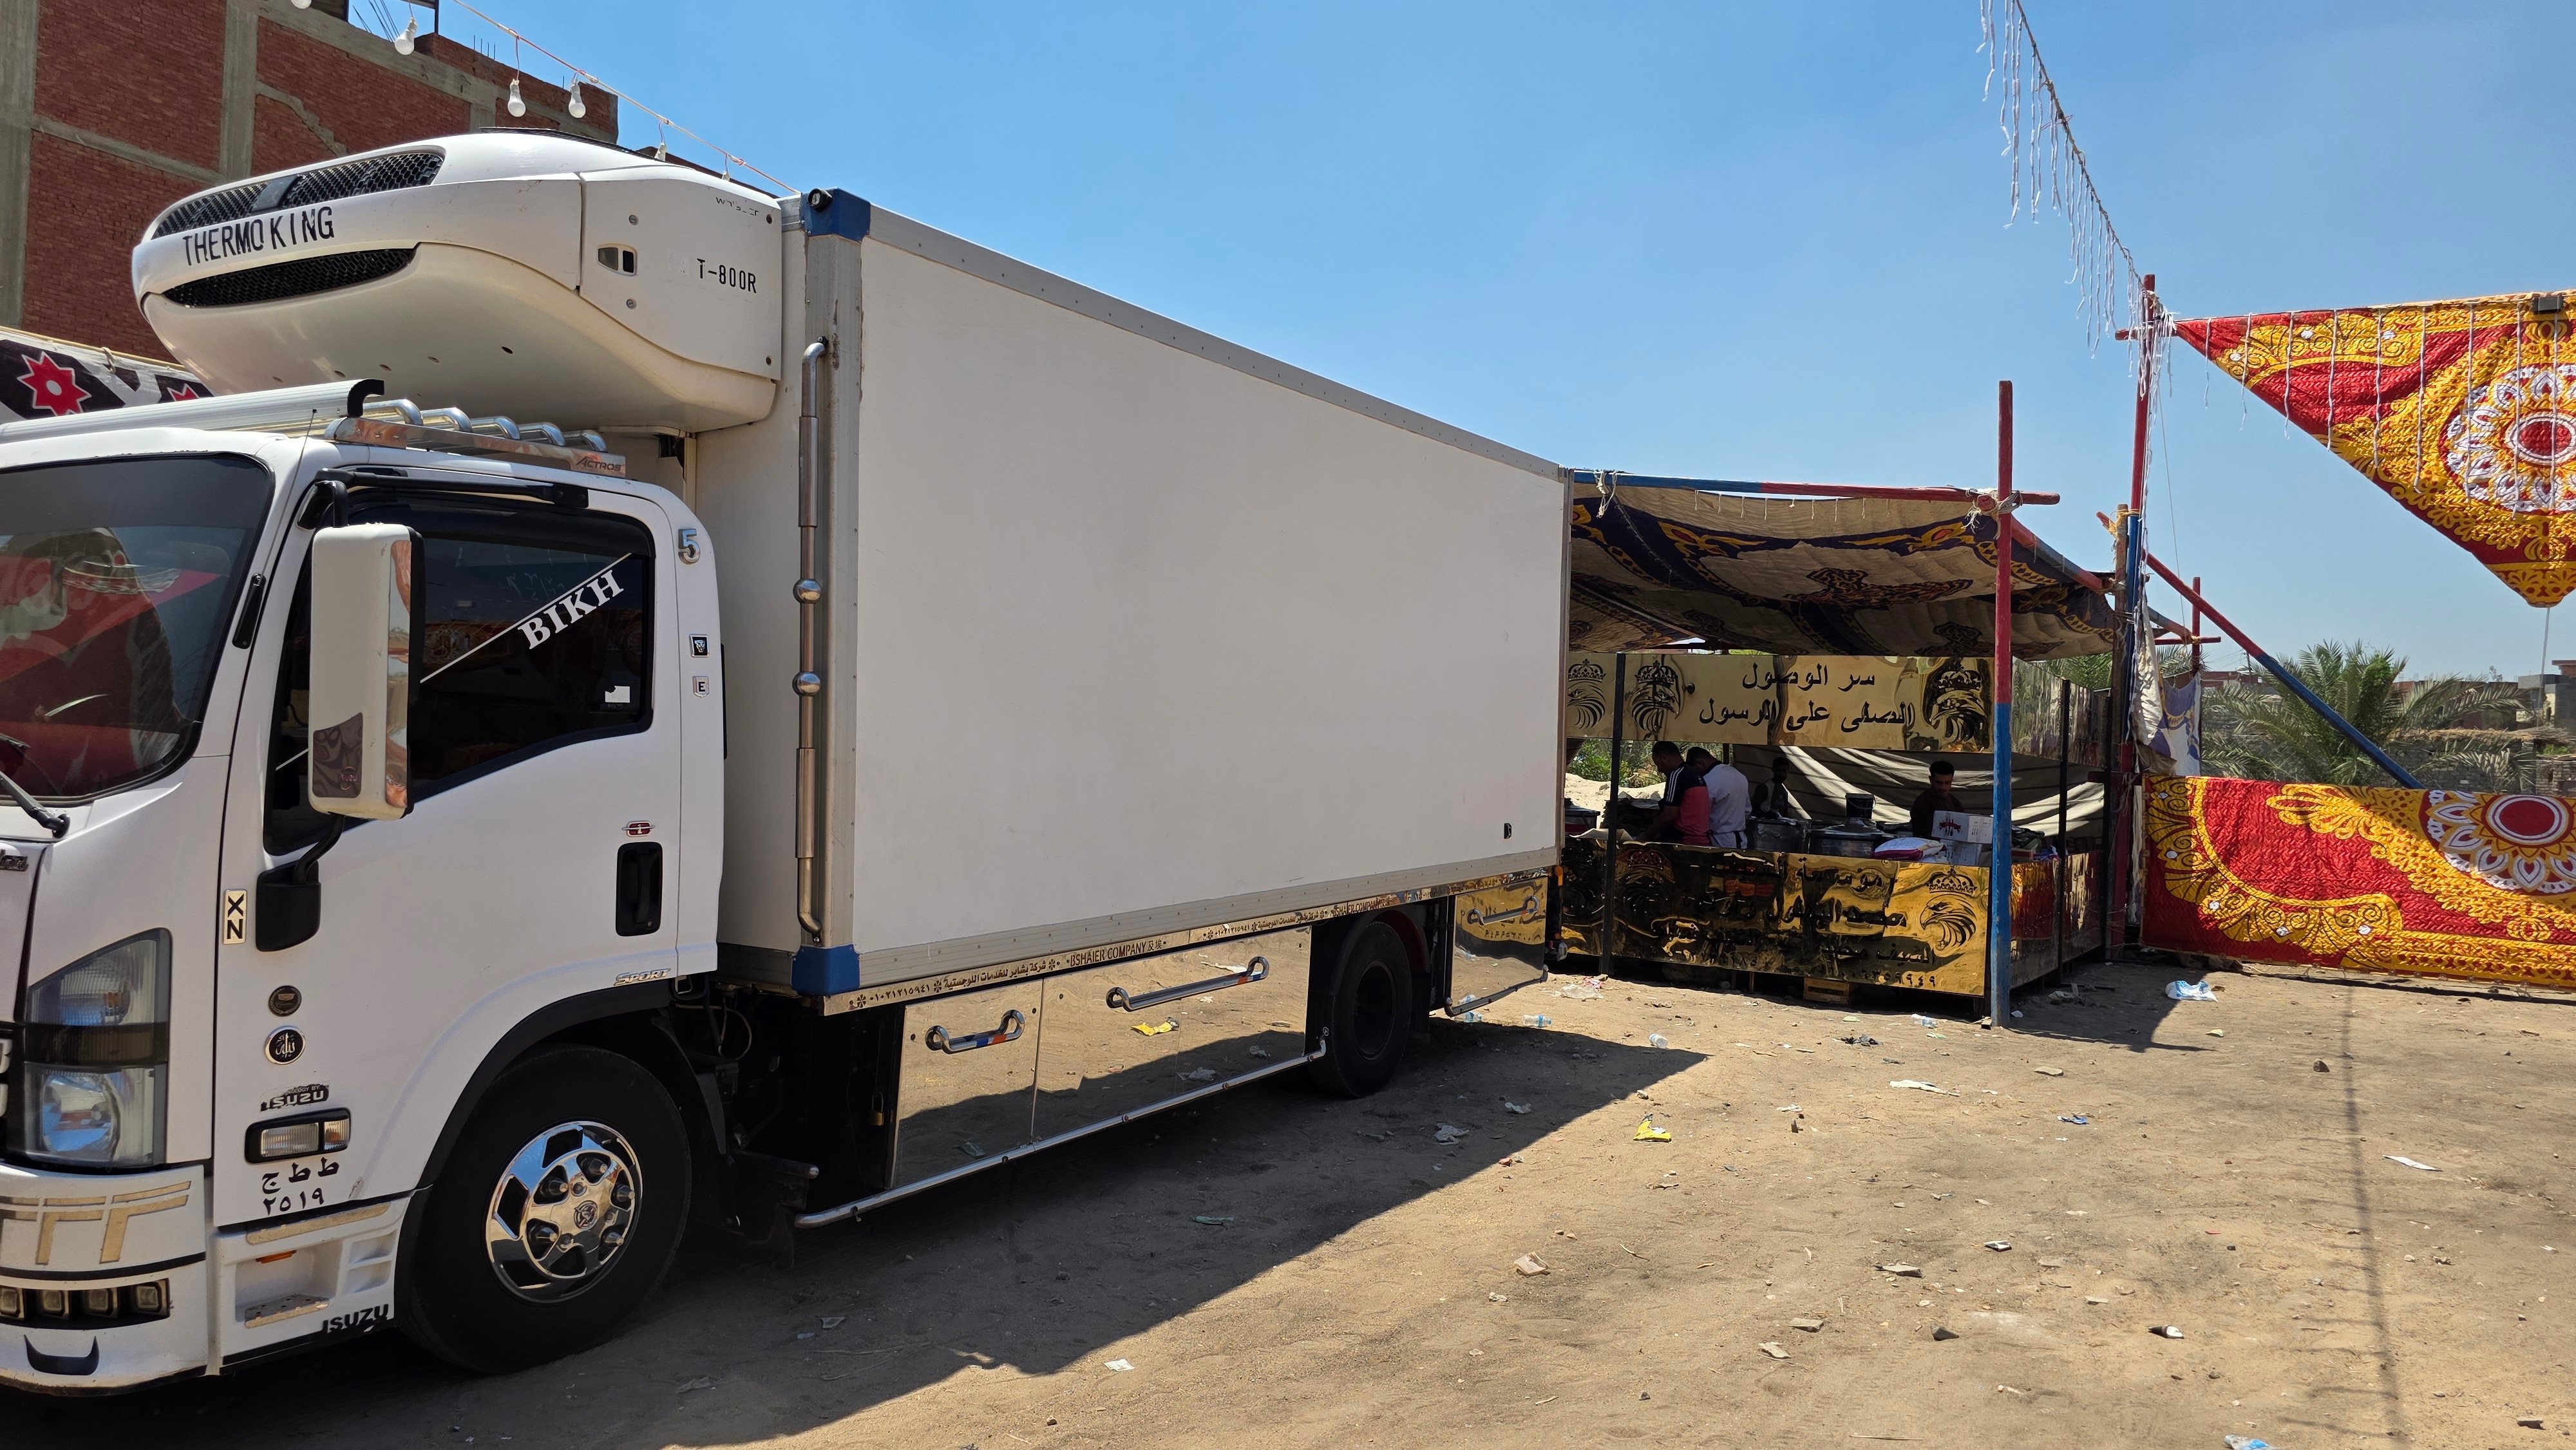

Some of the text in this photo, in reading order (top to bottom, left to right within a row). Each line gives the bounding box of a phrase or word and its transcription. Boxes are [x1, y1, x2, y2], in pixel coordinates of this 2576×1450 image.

[182, 206, 335, 266] THERMO KING
[697, 258, 757, 294] T-800R
[575, 456, 622, 472] ACTROS
[678, 529, 701, 564] 5
[517, 569, 624, 650] BIKH
[698, 681, 706, 692] E
[1742, 662, 1875, 692] سر الوصول
[1699, 697, 1779, 727] الرسول
[1786, 699, 1830, 731] على
[1030, 959, 1047, 972] شركة
[1070, 941, 1146, 966] BSHAIER COMPANY
[613, 968, 671, 986] SPORT
[266, 1090, 324, 1108] ISUZU
[261, 1156, 340, 1194] ط ط ج
[263, 1187, 325, 1216] ٢٥١٩
[322, 1304, 389, 1333] ISUZU
